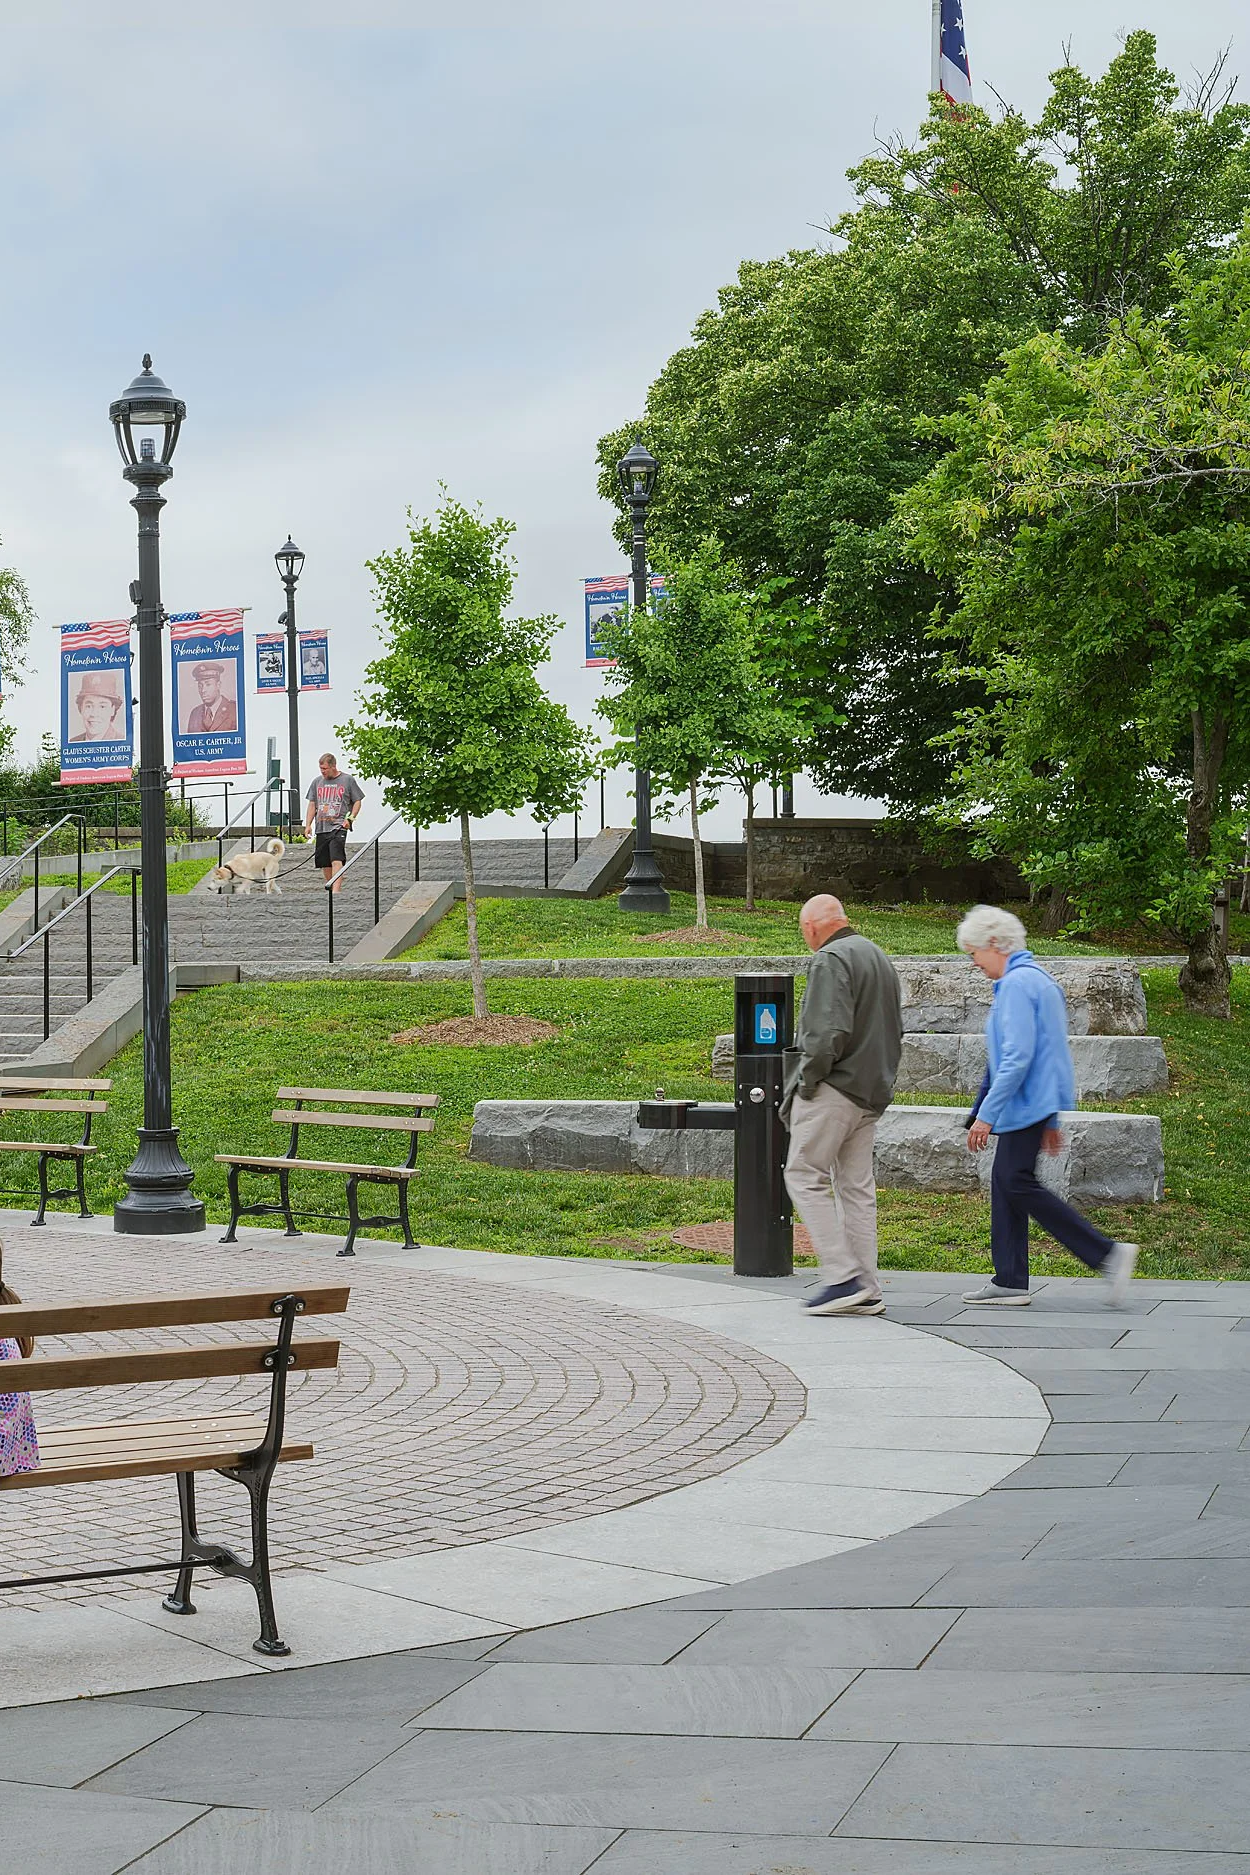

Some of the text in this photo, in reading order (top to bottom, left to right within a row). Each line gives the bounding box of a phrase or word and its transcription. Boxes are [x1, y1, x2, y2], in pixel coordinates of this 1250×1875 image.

[173, 638, 240, 656] Hometown Heroes
[64, 649, 127, 667] Hometown Heroes
[206, 738, 233, 746] CARTER,
[234, 737, 242, 745] JR
[63, 747, 83, 755] GLADYS
[110, 745, 131, 753] CARTER
[92, 755, 110, 763] ARMY
[317, 786, 345, 803] BULLS
